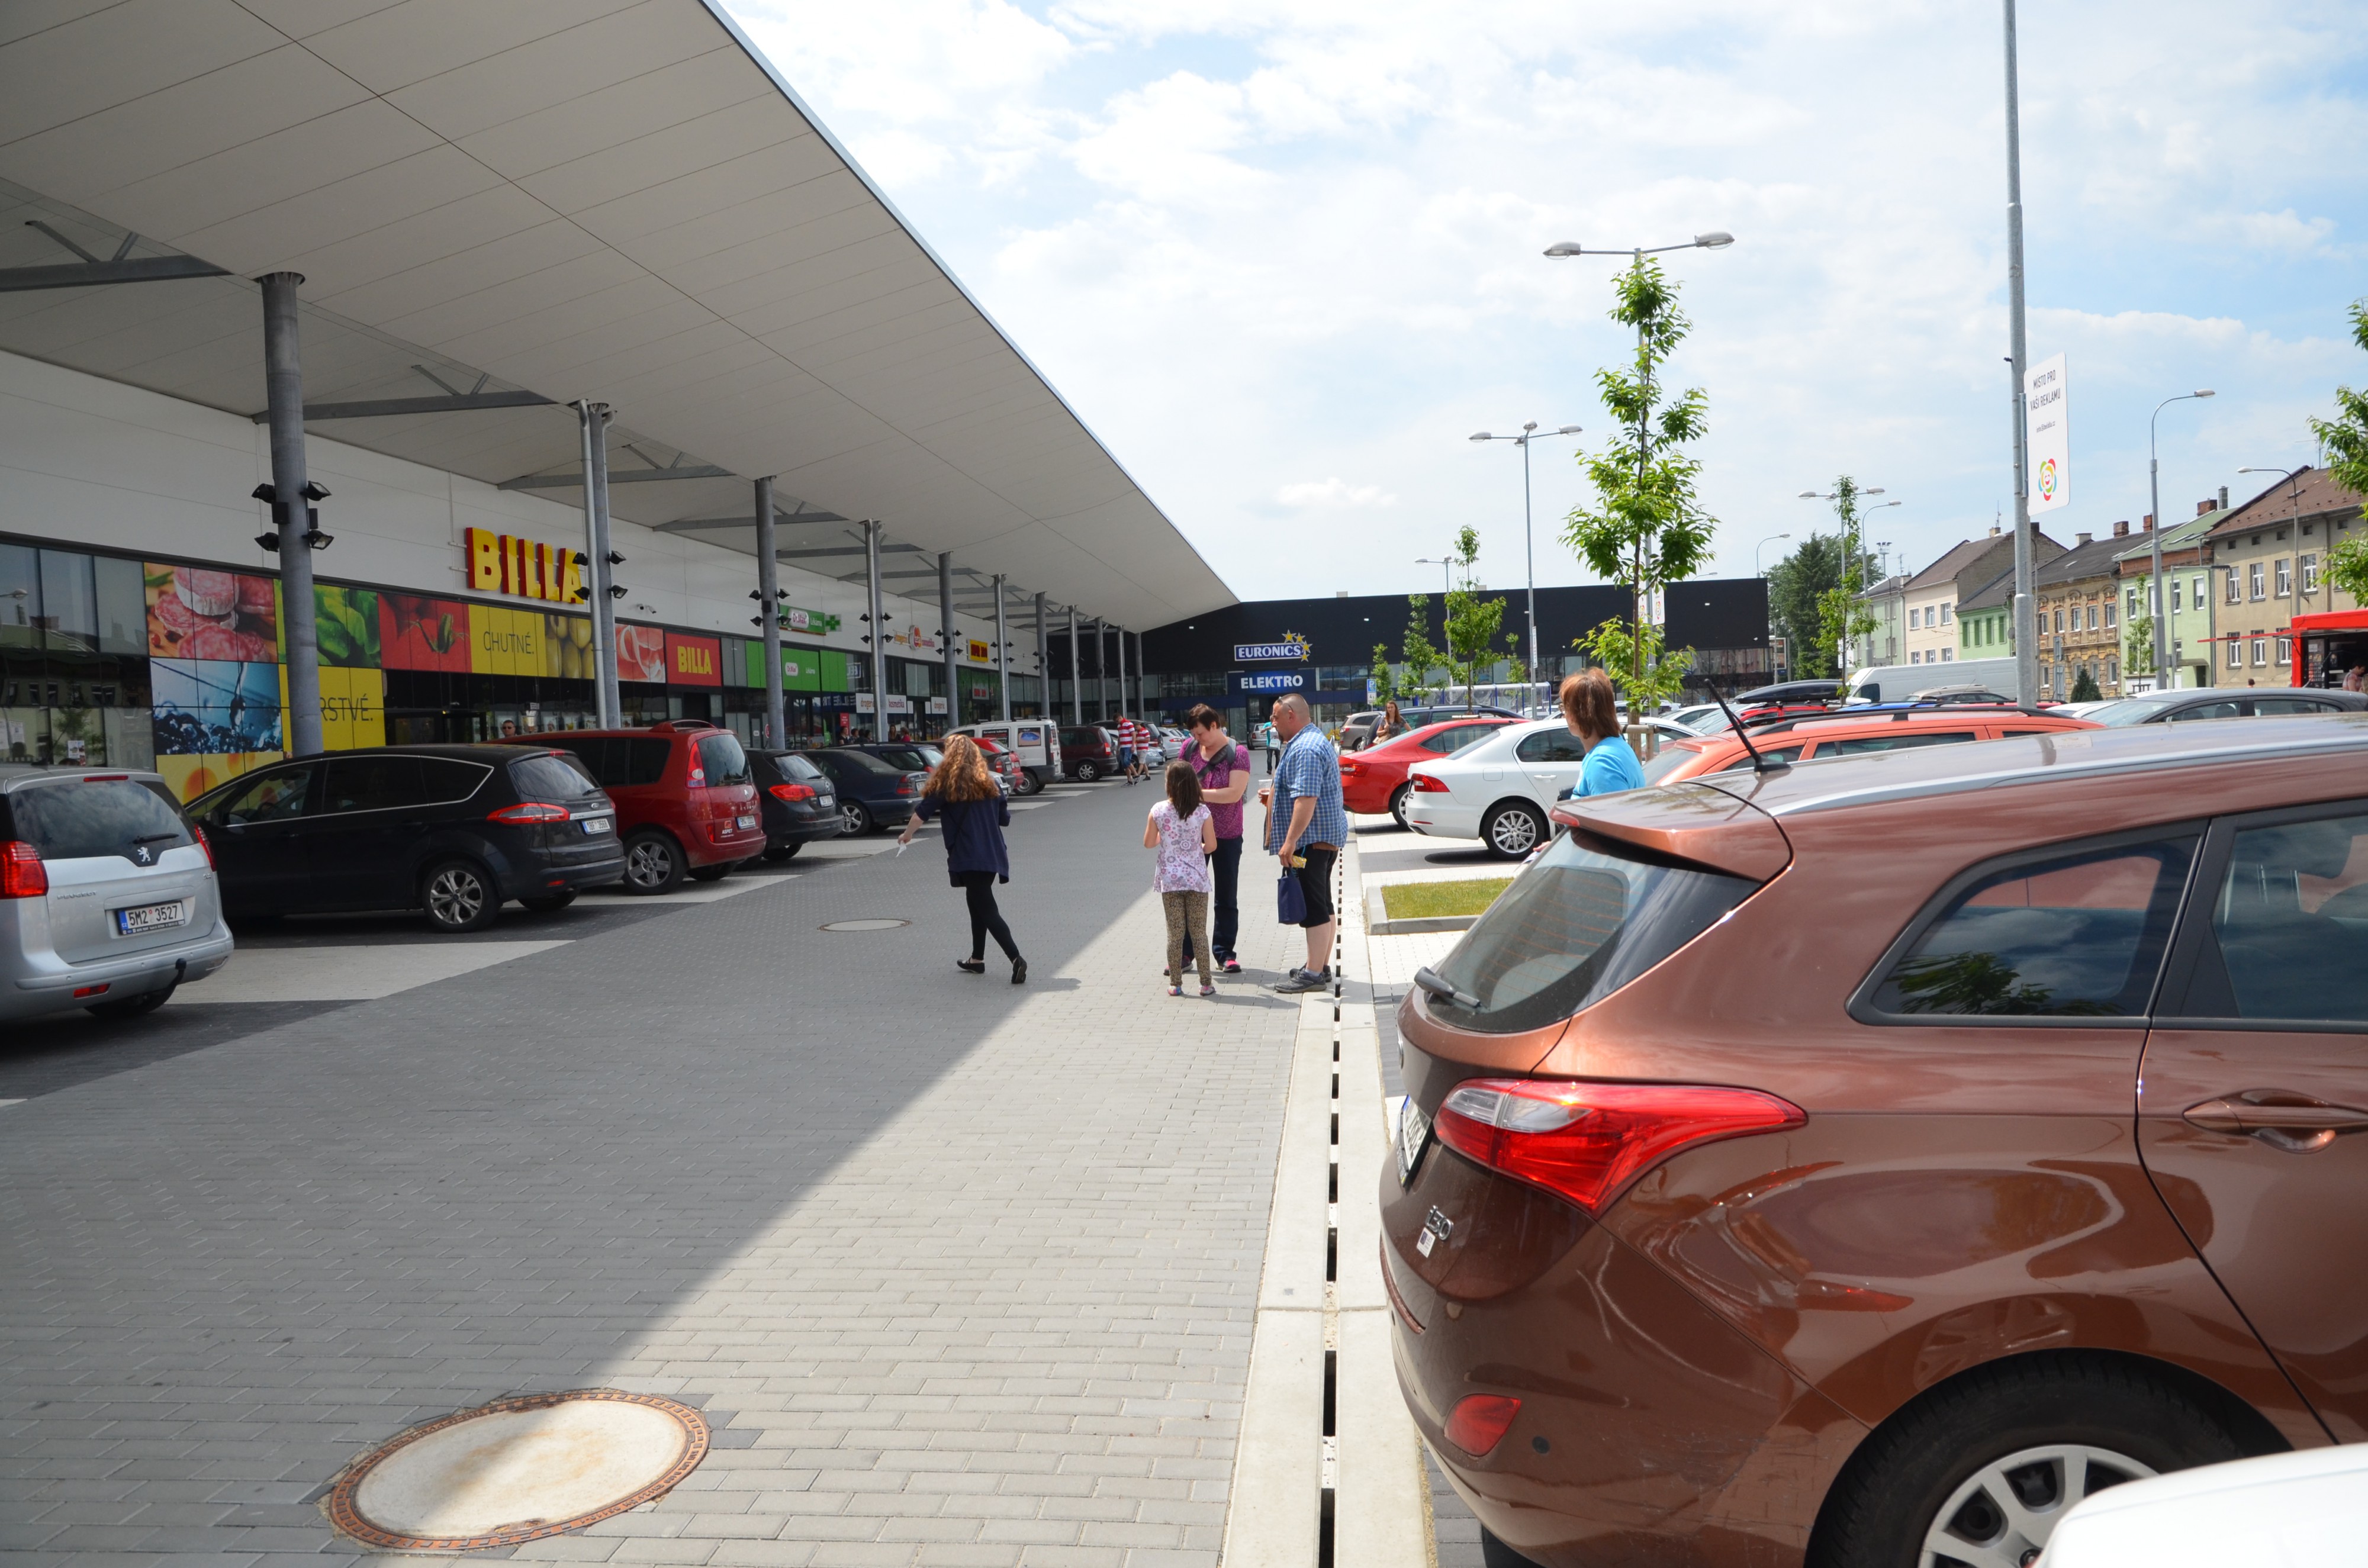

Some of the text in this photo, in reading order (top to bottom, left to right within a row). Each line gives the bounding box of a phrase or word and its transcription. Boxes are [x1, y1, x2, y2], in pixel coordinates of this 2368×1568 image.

[2033, 369, 2055, 390] MÍSTO PRO
[2030, 388, 2060, 411] VAŠI REKLAMU
[465, 527, 584, 604] BILLA
[483, 631, 534, 654] CHUTNÉ.
[1238, 645, 1301, 658] EURONICS
[677, 645, 712, 675] BILLA
[1241, 675, 1304, 689] ELEKTRO
[320, 693, 373, 722] RSTVÉ.
[128, 905, 178, 926] 5M2 3527
